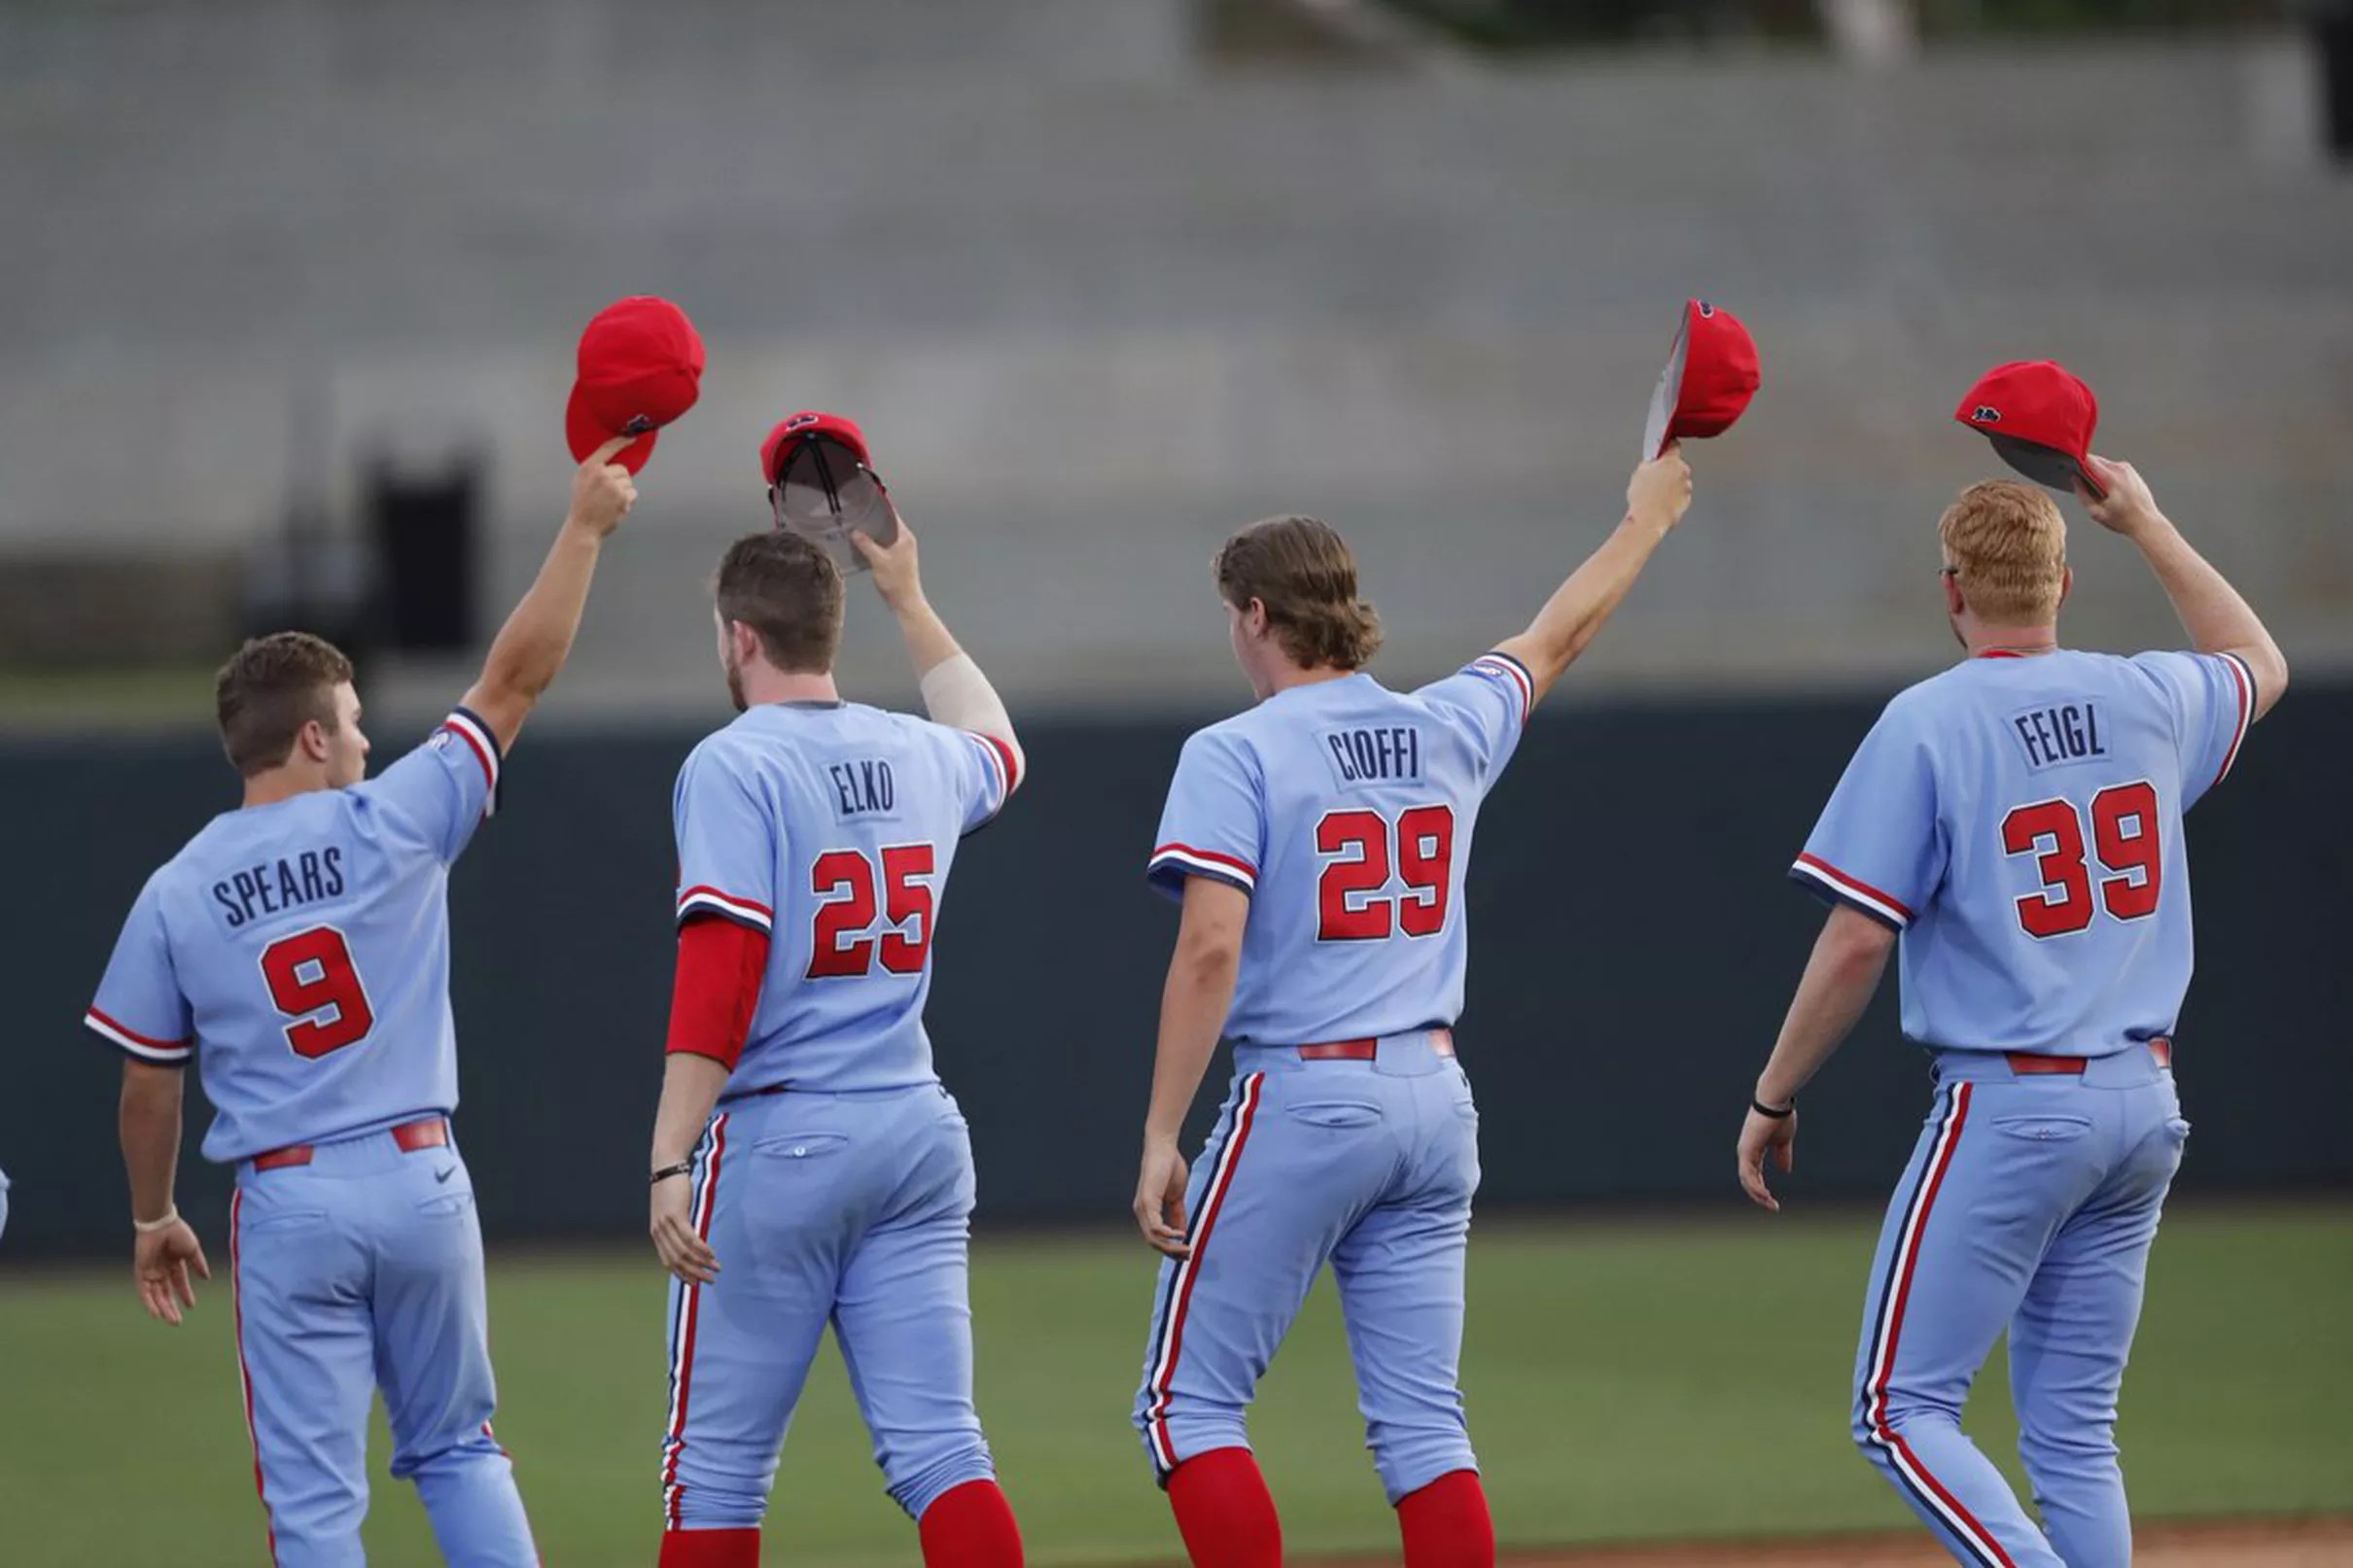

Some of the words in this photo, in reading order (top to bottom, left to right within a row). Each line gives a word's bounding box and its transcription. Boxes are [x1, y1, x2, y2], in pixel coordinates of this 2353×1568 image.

[829, 760, 894, 816] ELKO
[1327, 728, 1419, 782] CIOFFI
[2015, 704, 2105, 767] FEIGL
[213, 846, 344, 927] SPEARS
[803, 841, 935, 982] 25
[1314, 802, 1455, 943] 29
[2000, 779, 2162, 941] 39
[258, 923, 376, 1063] 9
